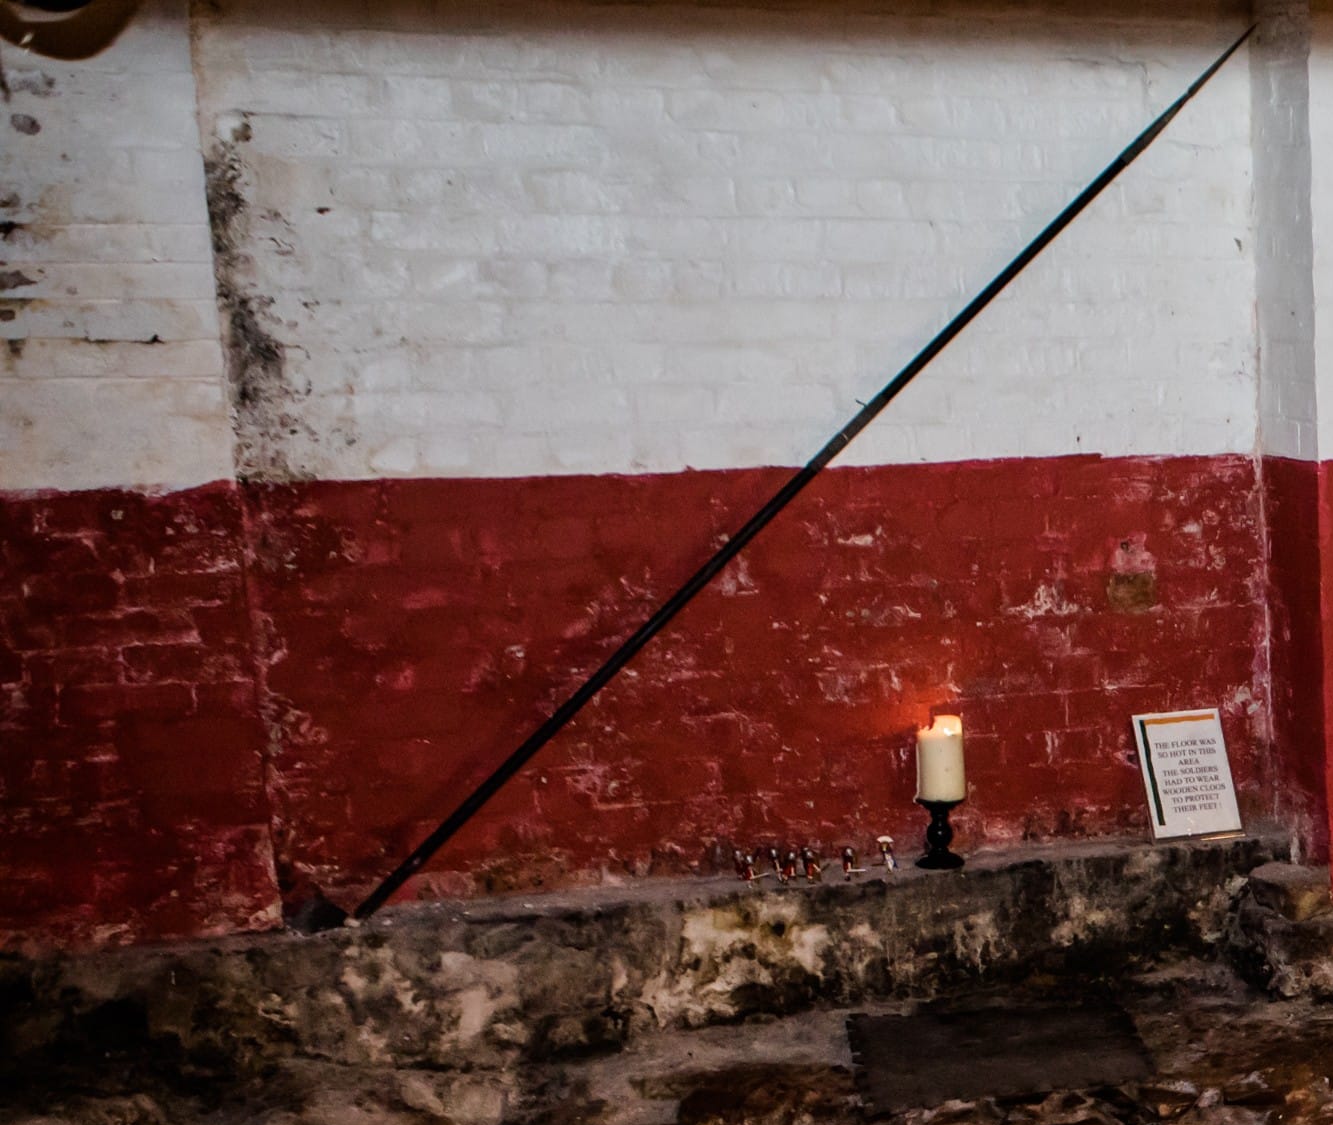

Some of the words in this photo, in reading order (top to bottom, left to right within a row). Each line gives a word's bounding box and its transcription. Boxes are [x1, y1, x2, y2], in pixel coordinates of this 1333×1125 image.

[1171, 740, 1198, 748] FLOOR
[1170, 749, 1186, 758] HOT
[1199, 747, 1216, 755] THIS
[1179, 758, 1200, 766] AREA
[1180, 766, 1218, 774] SOLDIERS
[1165, 778, 1183, 786] HAD
[1196, 774, 1220, 782] WEAR
[1162, 786, 1199, 795] WOODEN
[1172, 796, 1183, 804] TO
[1184, 793, 1219, 802] PROTECT
[1173, 804, 1197, 813] THEIR
[1199, 802, 1217, 810] FEET
